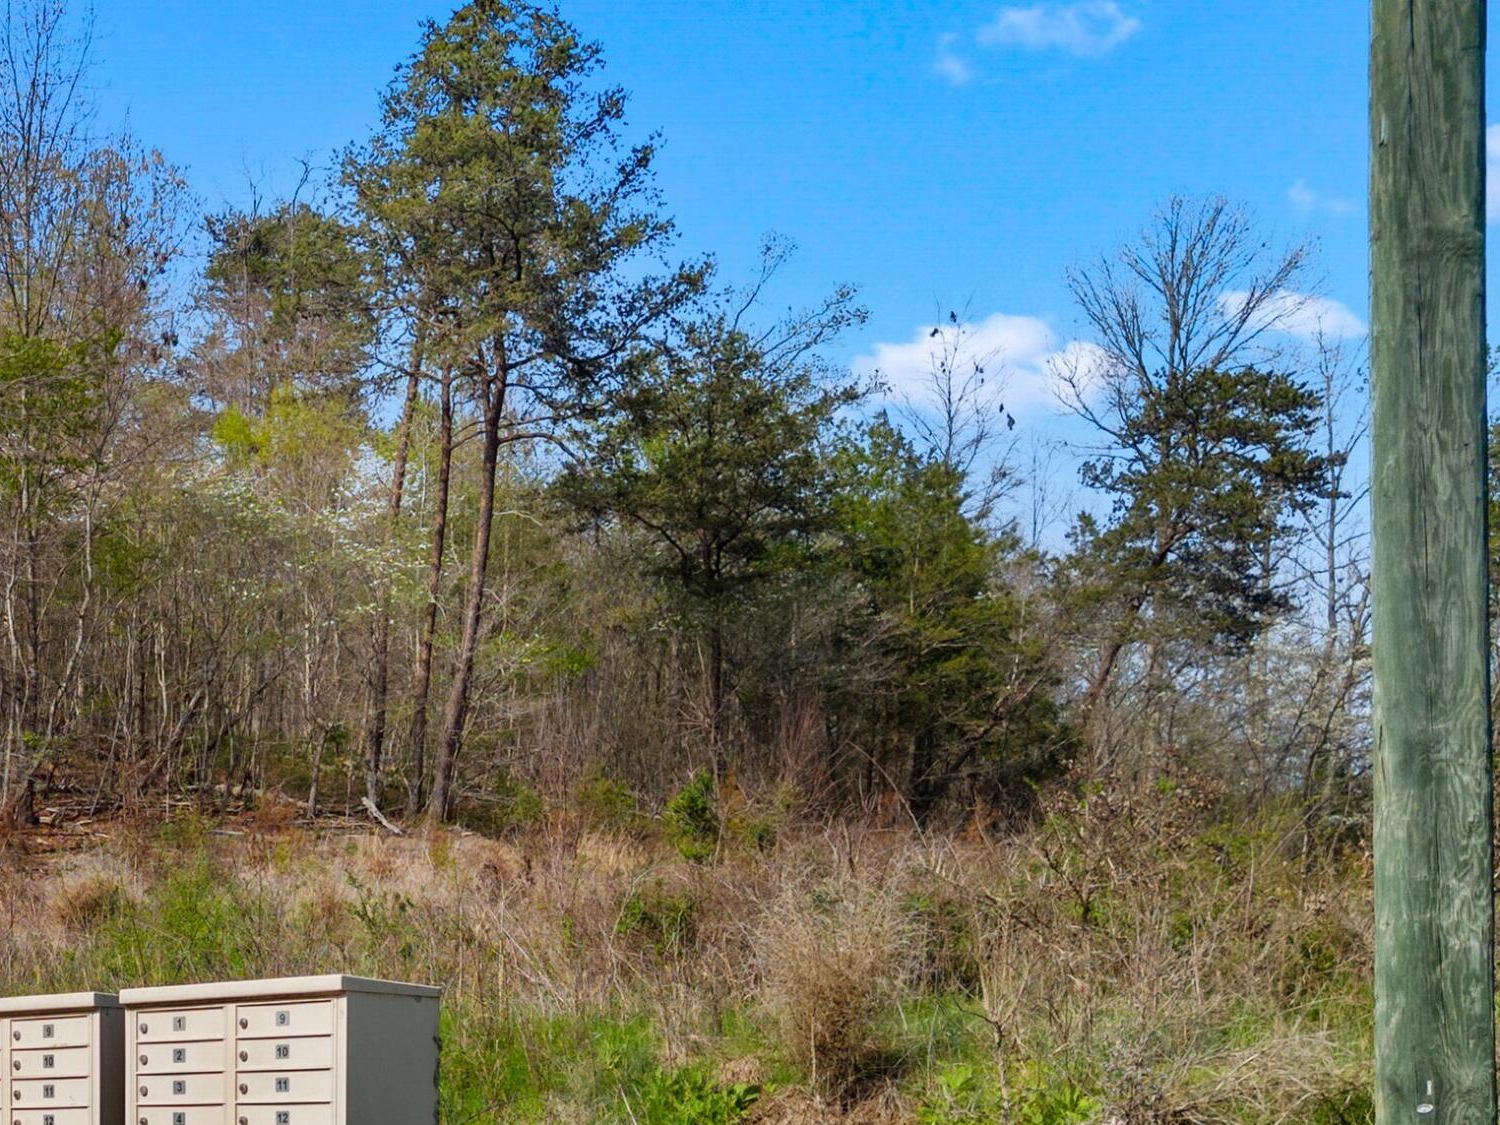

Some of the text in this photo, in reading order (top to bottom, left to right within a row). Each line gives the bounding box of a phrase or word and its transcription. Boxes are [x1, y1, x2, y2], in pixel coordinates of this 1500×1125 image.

[176, 1018, 182, 1029] 1
[279, 1013, 286, 1025] 9
[176, 1049, 182, 1061] 2
[276, 1046, 289, 1057] 10
[44, 1056, 54, 1067] 10
[176, 1081, 183, 1093] 3
[277, 1079, 288, 1090] 11
[45, 1086, 54, 1097] 11
[176, 1114, 182, 1124] 4
[277, 1112, 289, 1124] 12
